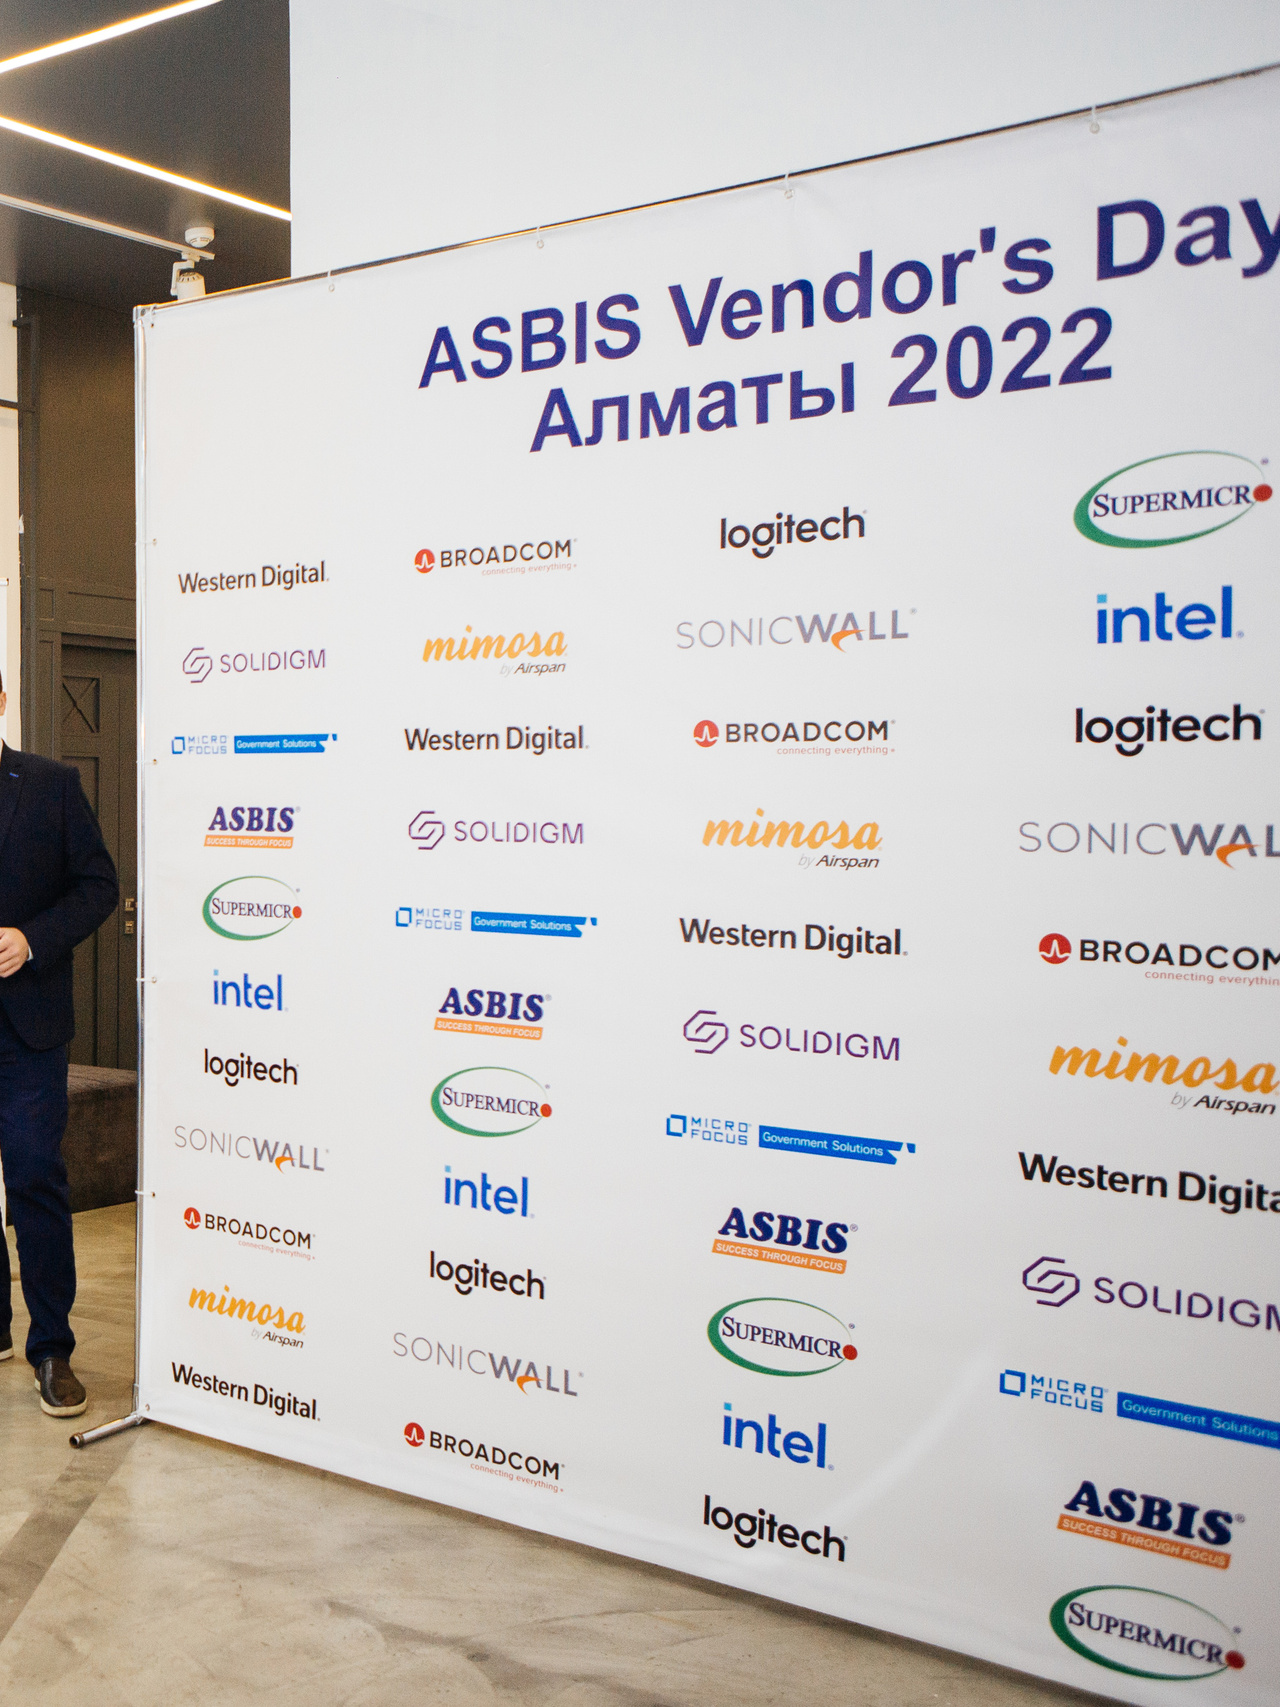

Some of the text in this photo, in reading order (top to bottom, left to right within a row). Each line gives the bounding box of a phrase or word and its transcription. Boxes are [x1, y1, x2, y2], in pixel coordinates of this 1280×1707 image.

[418, 198, 1280, 389] ASBIS Vendor's Day
[529, 308, 1113, 453] Алматы 2022
[720, 507, 865, 558] logitech
[440, 540, 572, 568] BROADCOM
[482, 562, 571, 577] connecting everything
[178, 561, 325, 593] Western Digital
[676, 610, 909, 652] SONICWALL
[1097, 586, 1232, 644] intel
[422, 625, 568, 661] mimosa
[220, 649, 326, 673] SOLIDIGM
[514, 662, 565, 676] Airspan
[188, 736, 227, 744] MICRO
[237, 740, 279, 748] Government
[405, 725, 585, 755] Western Digital
[726, 720, 888, 743] BROADCOM
[1076, 704, 1262, 756] logitech
[189, 746, 227, 754] FOCUS
[777, 745, 888, 756] connecting everything
[208, 806, 295, 832] ASBIS
[454, 820, 584, 844] SOLIDIGM
[702, 808, 883, 850] mimosa
[798, 854, 880, 871] by Airspan
[1019, 822, 1280, 868] SONICWAL
[416, 909, 462, 919] MICRO
[416, 919, 462, 930] FOCUS
[474, 917, 571, 931] Government Solutions
[680, 918, 901, 959] Western Digital
[213, 970, 283, 1011] intel
[1144, 970, 1280, 988] connecting everythin
[439, 987, 544, 1022] ASBIS
[437, 1021, 540, 1038] SUCCESS THROUGH FOCUS
[740, 1024, 900, 1062] SOLIDIGM
[204, 1048, 297, 1086] logitech
[1049, 1036, 1280, 1094] mimosa
[1171, 1092, 1276, 1116] by Airspan
[692, 1116, 748, 1133] MICRO
[692, 1129, 748, 1146] FOCUS
[175, 1126, 325, 1172] SONICWALL
[763, 1132, 883, 1156] Government Solutions
[444, 1166, 528, 1218] intel
[1018, 1152, 1280, 1214] Western Digita
[205, 1214, 311, 1249] BROADCOM
[718, 1207, 849, 1254] ASBIS
[238, 1239, 311, 1260] connecting everything
[716, 1243, 843, 1271] SUCCESS THROUGH FOCUS
[430, 1251, 544, 1300] logitech
[189, 1285, 306, 1333] mimosa
[263, 1331, 304, 1349] Airspan
[393, 1332, 578, 1396] SONICWALL
[172, 1362, 316, 1421] Western Digital
[1031, 1374, 1103, 1398] MICRO
[1031, 1389, 1103, 1413] FOCUS
[723, 1402, 826, 1468] intel
[1122, 1400, 1278, 1441] Government Solutions
[429, 1431, 560, 1481] BROADCOM
[470, 1463, 559, 1493] connecting everything
[704, 1495, 846, 1562] logitech
[1064, 1481, 1233, 1545] ASBIS
[1062, 1518, 1226, 1566] SUCCESS THROUGH FOCUS
